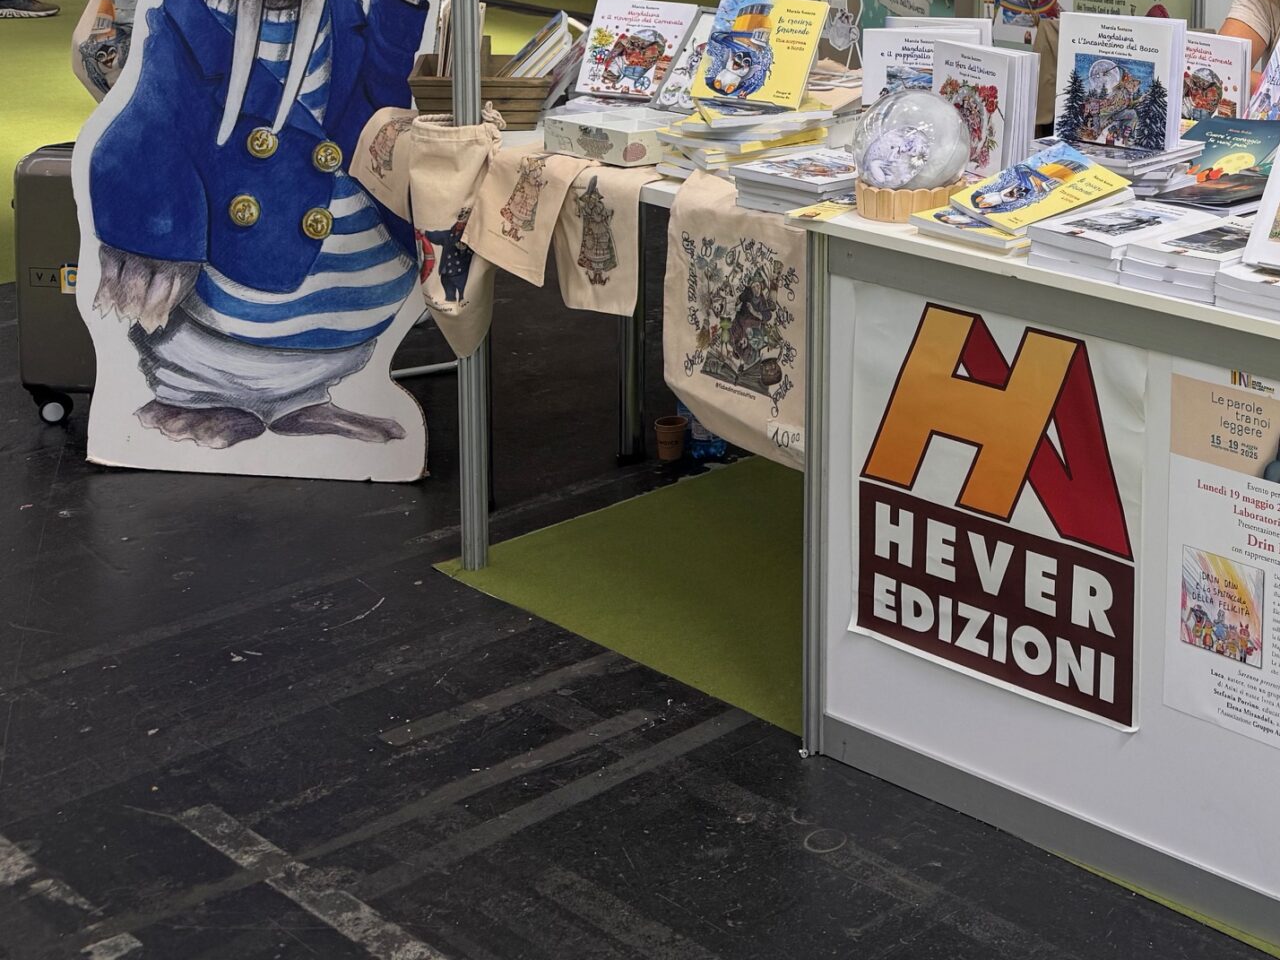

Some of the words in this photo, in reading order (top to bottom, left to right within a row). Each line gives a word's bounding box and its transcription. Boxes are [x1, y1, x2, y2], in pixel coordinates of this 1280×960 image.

[1197, 479, 1228, 497] Lunedì
[1230, 489, 1240, 500] 19
[1242, 493, 1275, 511] maggio
[874, 501, 1116, 638] HEVER
[1247, 533, 1275, 553] Drin
[873, 572, 1116, 705] EDIZIONI
